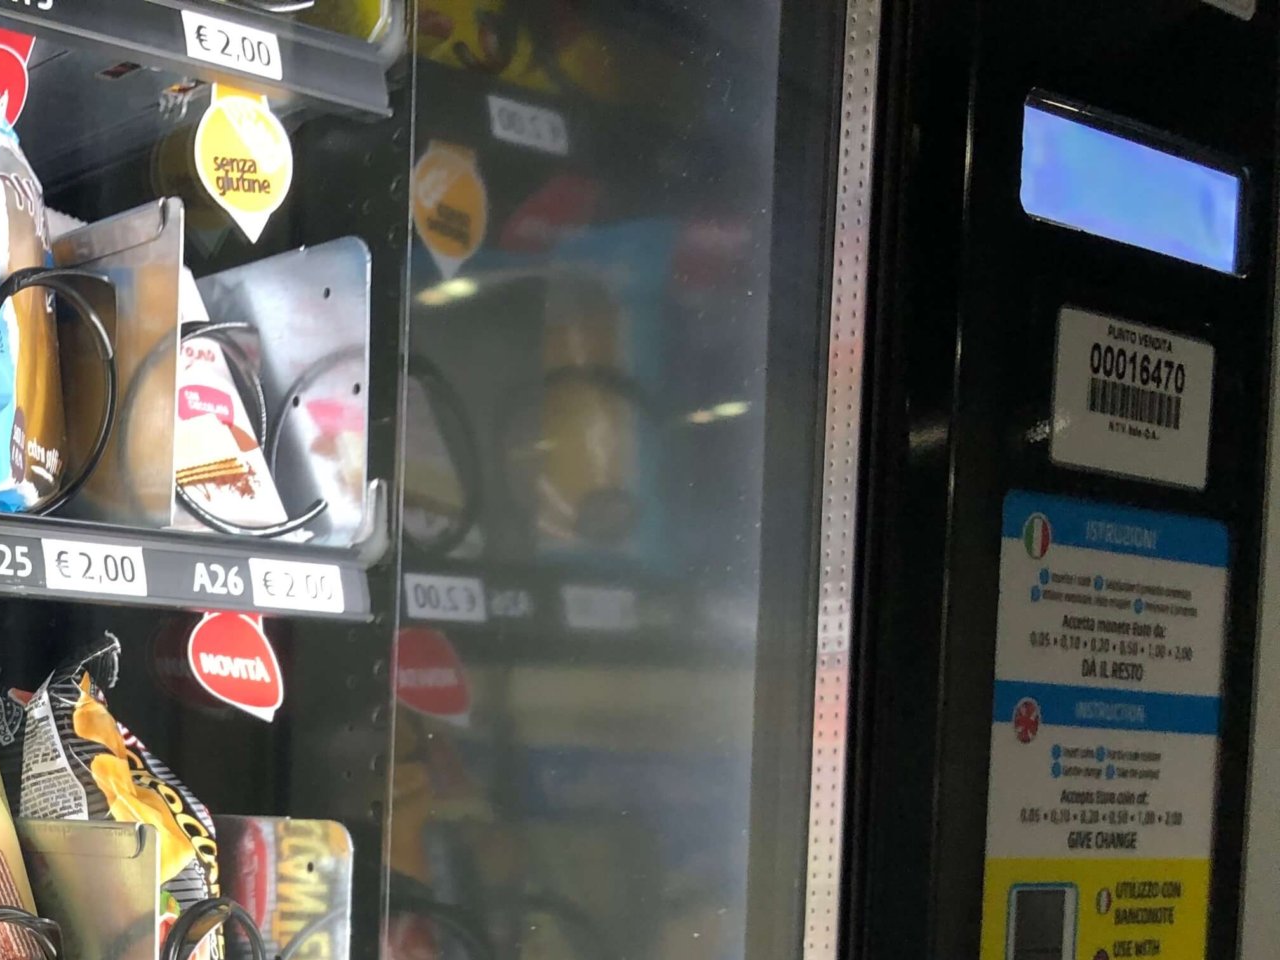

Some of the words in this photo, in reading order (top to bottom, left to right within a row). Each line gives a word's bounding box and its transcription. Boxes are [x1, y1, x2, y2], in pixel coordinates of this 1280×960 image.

[195, 25, 211, 51] €
[220, 30, 271, 67] 2,00
[213, 155, 257, 175] senza
[216, 172, 271, 196] glutine
[1107, 324, 1136, 345] PUNTO
[1138, 328, 1173, 354] VENDITA
[1089, 342, 1186, 394] 00016470
[55, 550, 72, 578] €
[82, 551, 136, 584] 2,00
[193, 562, 244, 596] A26
[199, 651, 272, 683] NOVITÀ
[1111, 662, 1144, 682] RESTO
[1067, 831, 1093, 850] GIVE
[1094, 831, 1138, 850] CHANGE
